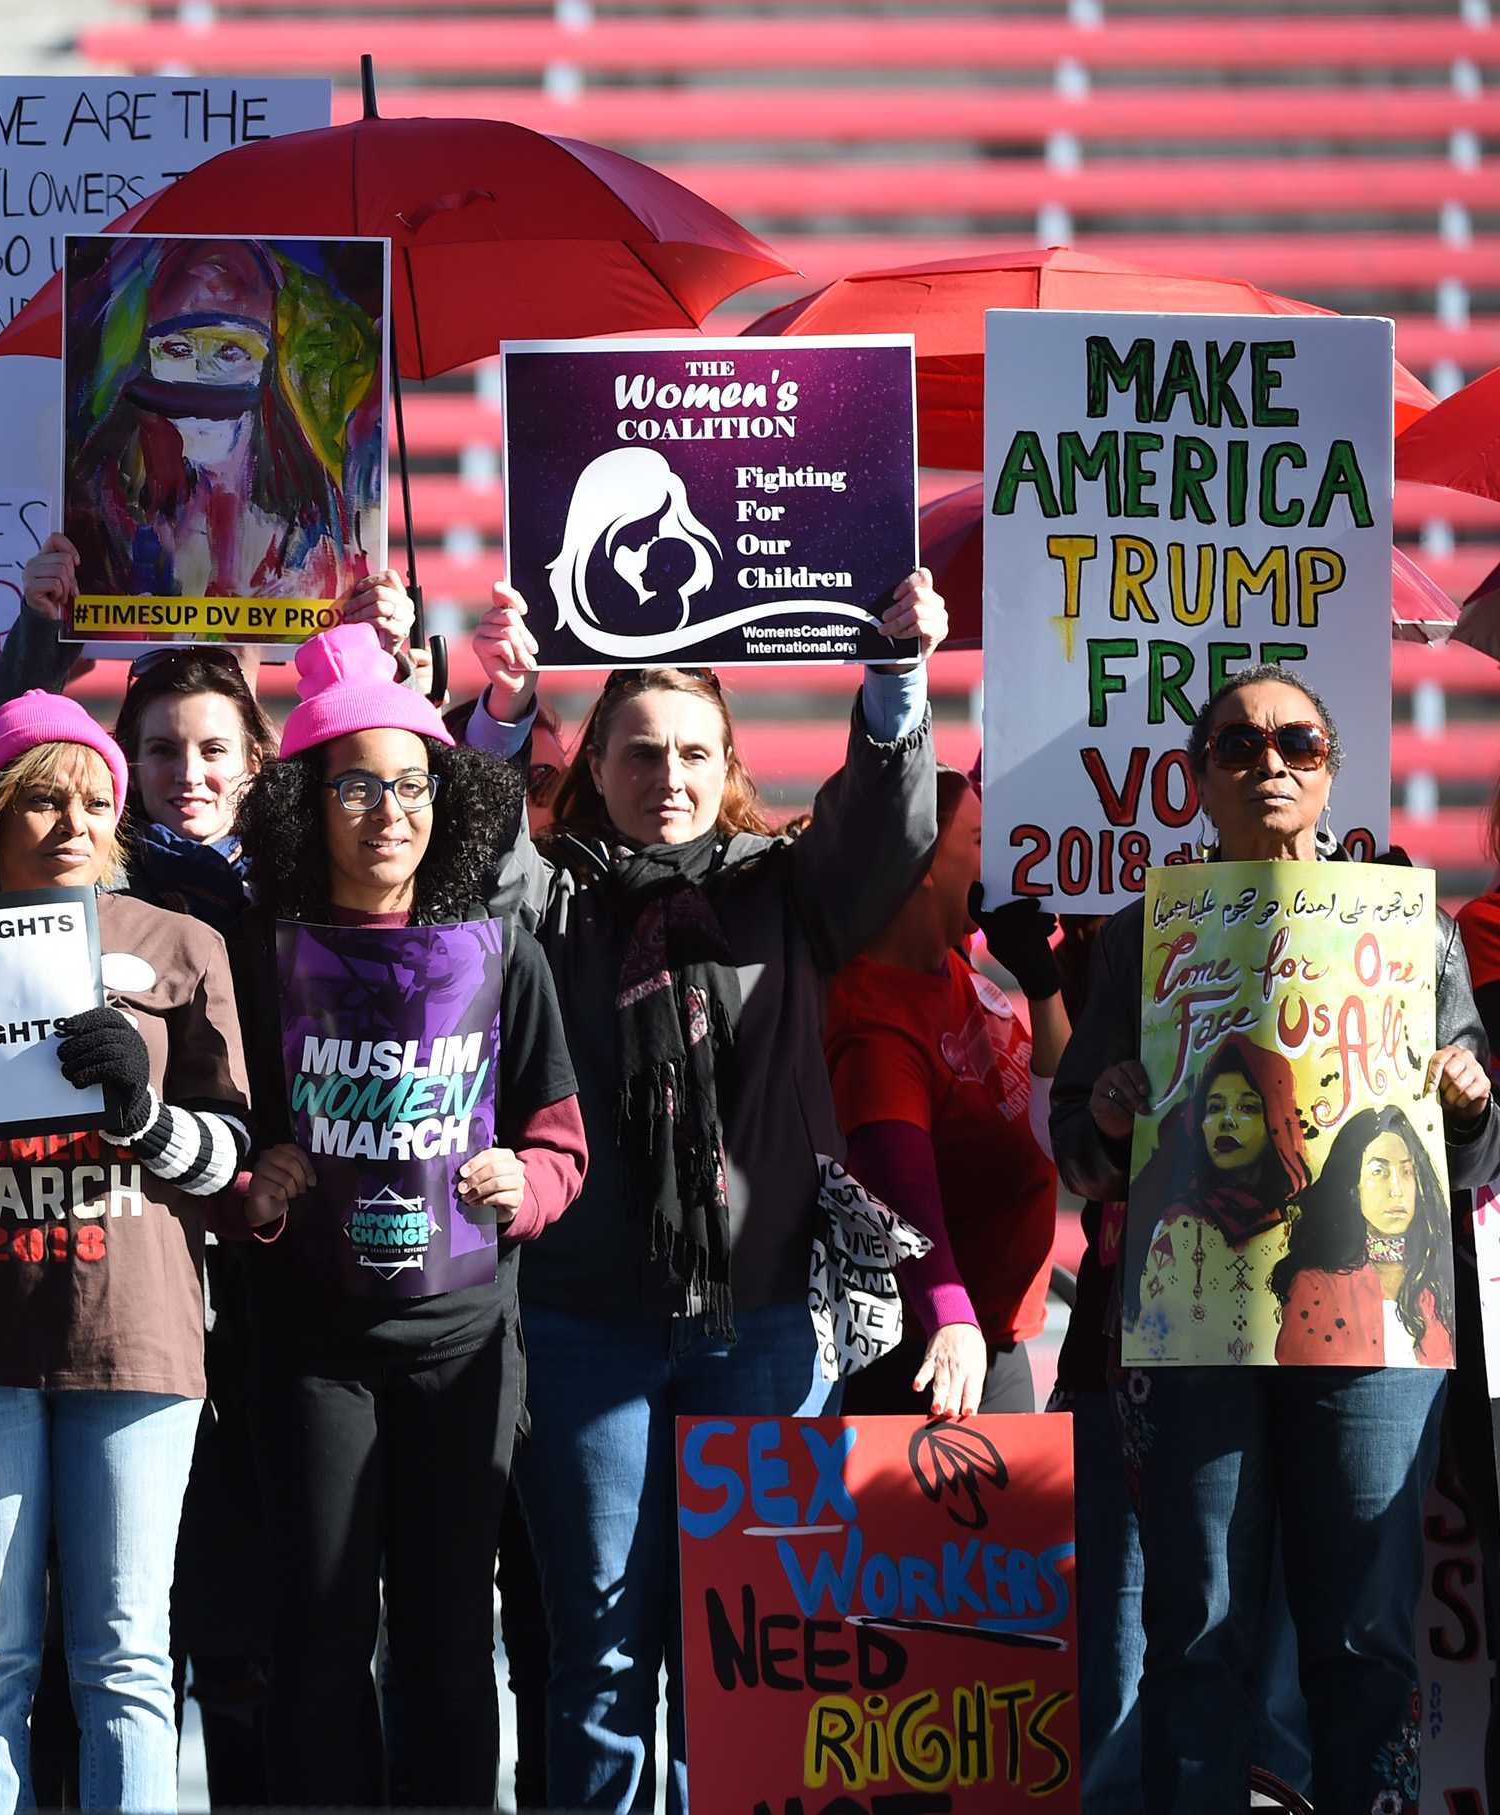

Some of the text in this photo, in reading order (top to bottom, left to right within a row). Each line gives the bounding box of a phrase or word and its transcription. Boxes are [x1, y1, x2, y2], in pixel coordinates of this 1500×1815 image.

[63, 90, 157, 146] ARE
[172, 89, 271, 144] THE
[614, 369, 799, 413] Women's
[685, 360, 735, 377] THE
[1085, 335, 1300, 429] MAKE
[616, 416, 797, 441] COALITION
[734, 465, 847, 493] Fighting
[991, 430, 1376, 529] AMERICA
[735, 500, 786, 522] For
[736, 534, 791, 556] Our
[737, 567, 853, 589] Children
[1046, 534, 1347, 629] TRUMP
[74, 604, 198, 626] #TIMESUP
[206, 606, 240, 627] DV
[248, 607, 277, 628] BY
[741, 624, 861, 640] WomensCoalition
[746, 640, 857, 655] International.org
[1009, 823, 1152, 898] 2018
[1150, 931, 1240, 1004] Come
[1252, 927, 1330, 1002] for
[301, 1032, 484, 1080] MUSLIM
[1152, 984, 1261, 1111] Face
[1275, 995, 1331, 1059] Us
[1312, 994, 1407, 1127] All
[291, 1057, 490, 1131] WOMEN
[311, 1115, 472, 1161] MARCH
[351, 1227, 429, 1246] CHANGE
[678, 1420, 858, 1539] SEX
[776, 1524, 1075, 1632] WORKERS
[705, 1584, 908, 1692] NEED
